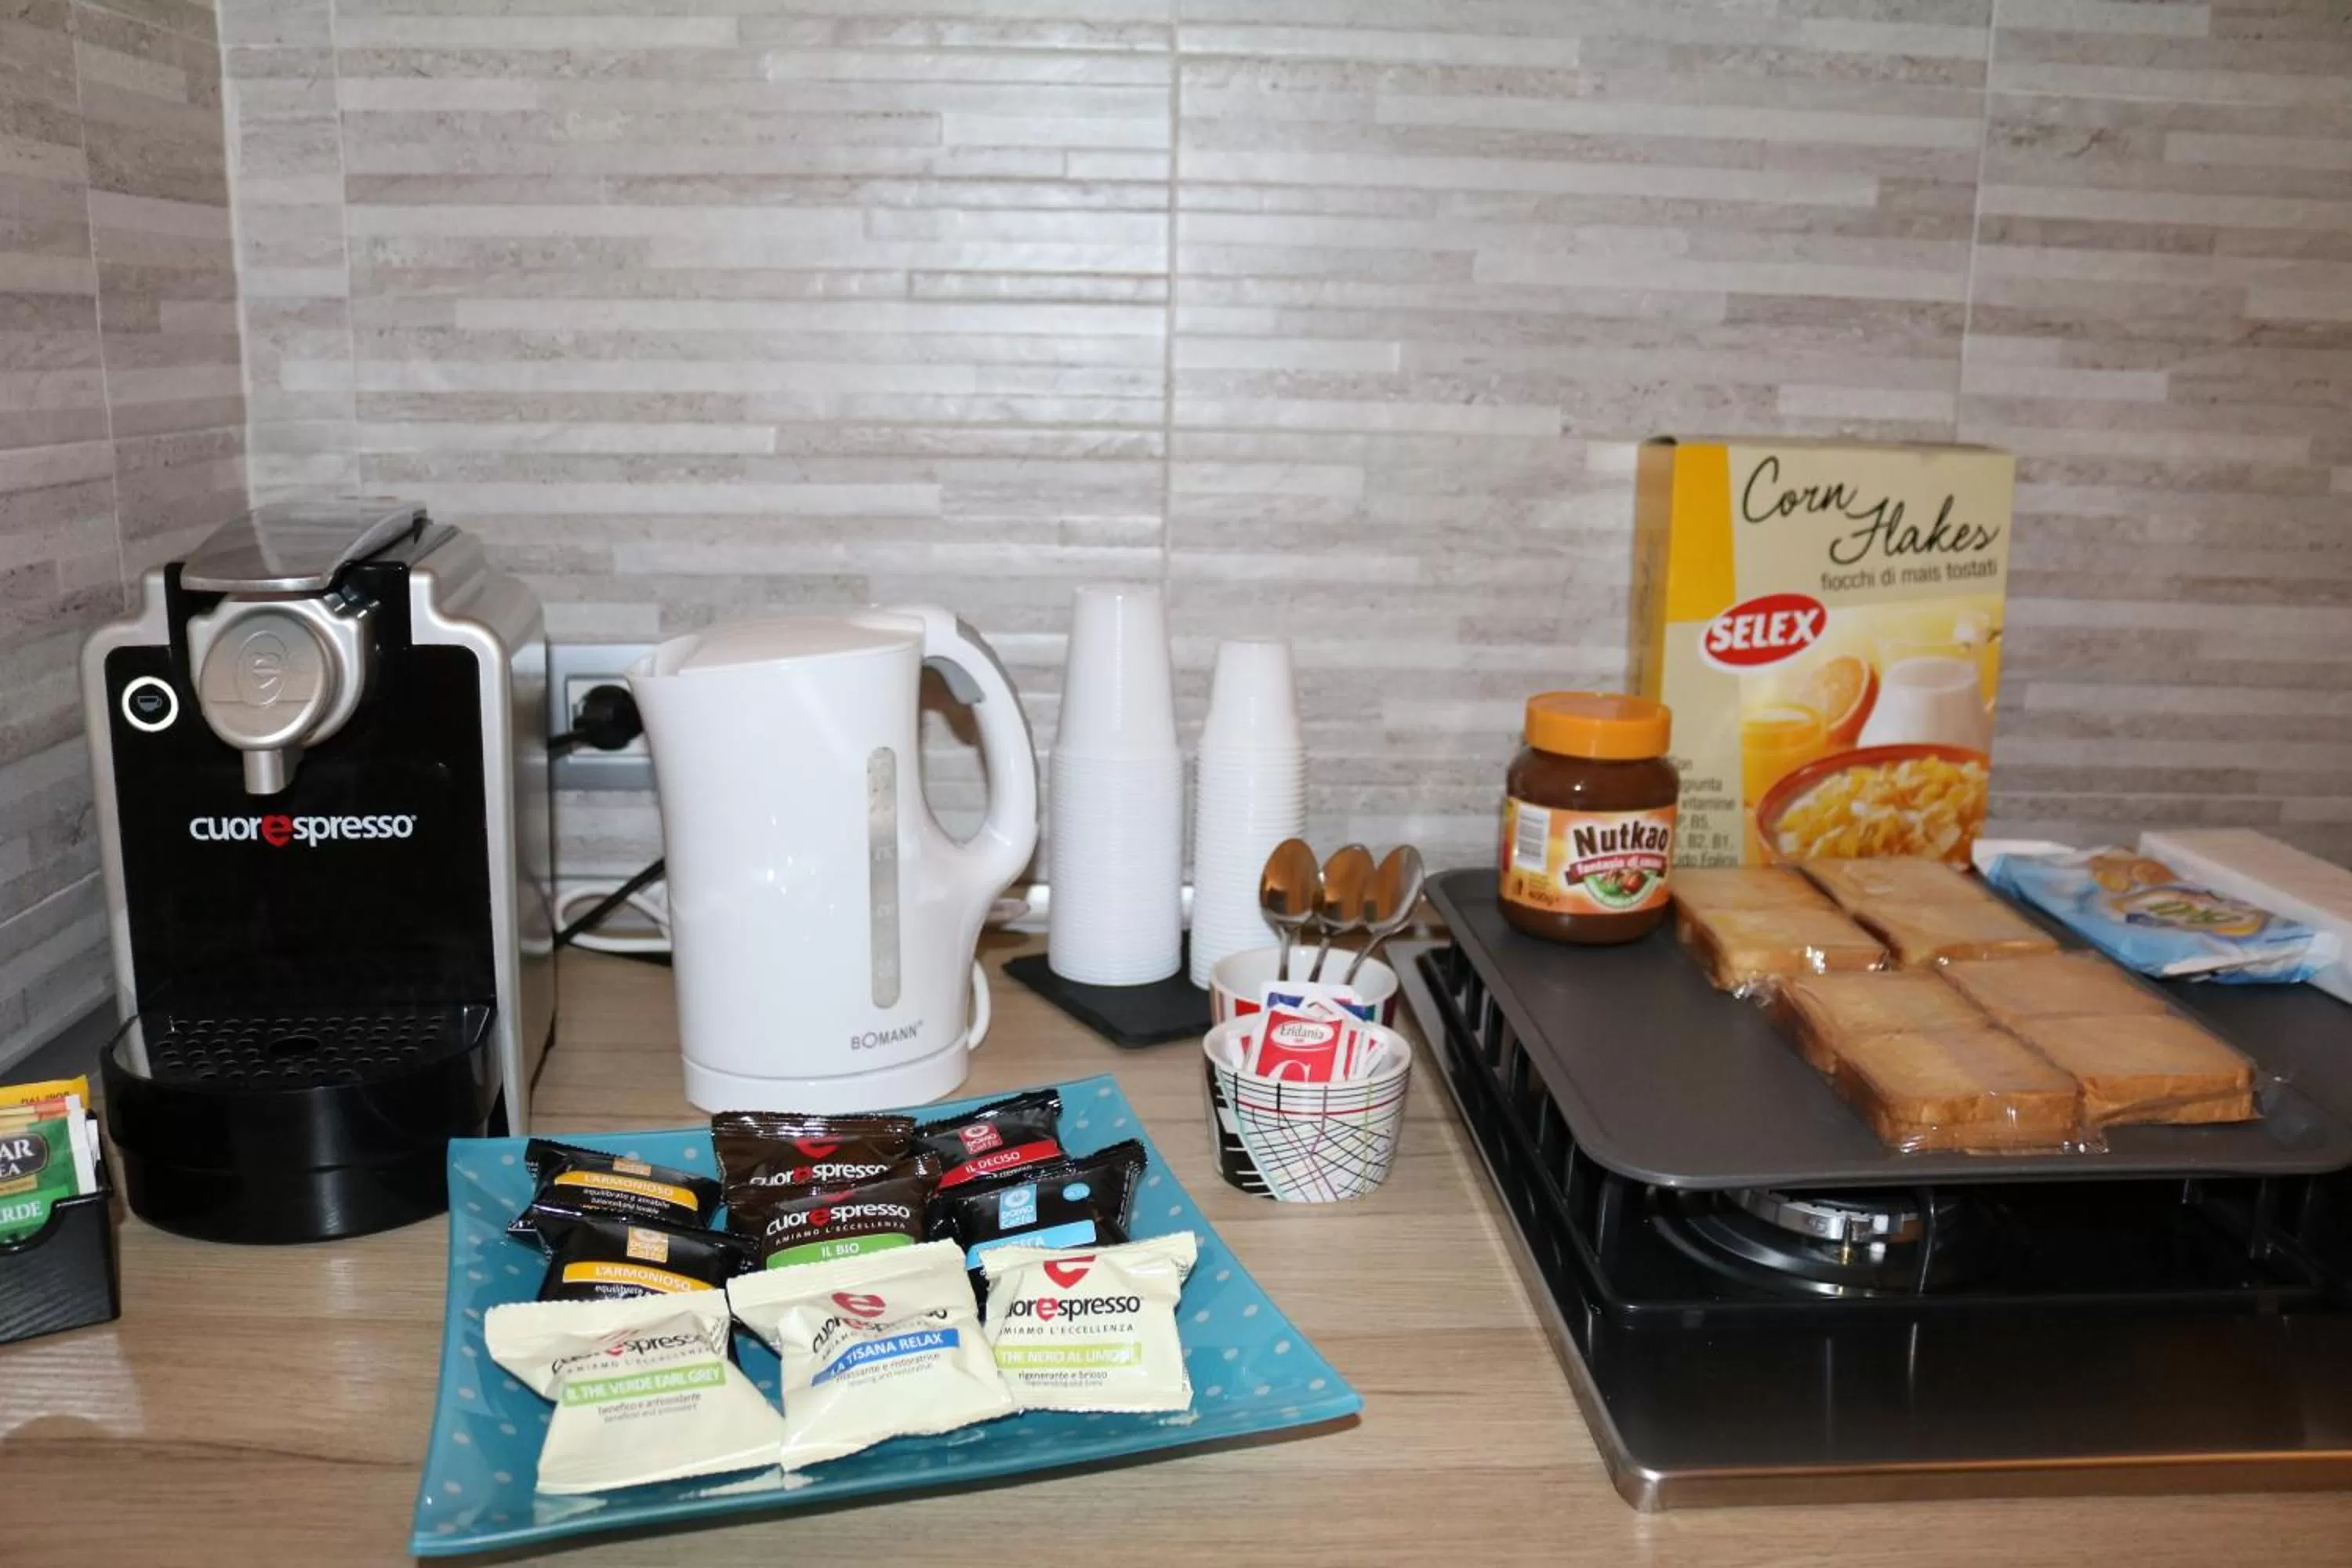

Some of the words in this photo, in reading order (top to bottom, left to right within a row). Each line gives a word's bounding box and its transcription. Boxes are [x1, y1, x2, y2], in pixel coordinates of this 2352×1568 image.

[1743, 456, 1857, 524] Corn
[1829, 494, 2002, 565] Flakes
[1820, 572, 1876, 592] fiocchi
[1881, 570, 1896, 586] di
[1901, 567, 1942, 584] mais
[1946, 558, 1998, 582] tostati
[1708, 607, 1820, 653] SELEX
[189, 814, 416, 848] cuorespresso
[1573, 820, 1668, 858] Nutkao
[851, 1023, 918, 1051] BOMANN
[1279, 1023, 1324, 1040] Eridania
[0, 1139, 34, 1161] AR
[965, 1165, 976, 1174] IL
[978, 1151, 1021, 1169] DECISO
[0, 1163, 21, 1178] EA
[0, 1200, 43, 1224] RDE
[765, 1203, 911, 1236] cuorespresso
[775, 1228, 820, 1247] AMIAMO
[821, 1247, 831, 1258] IL
[836, 1243, 860, 1256] BIO
[595, 1265, 691, 1293] L'ARMONIOSO
[1006, 1294, 1142, 1323] orespresso
[1000, 1327, 1044, 1335] MIAMO
[846, 1341, 898, 1364] TISANA
[898, 1331, 944, 1350] RELAX
[609, 1377, 653, 1396] VERDE
